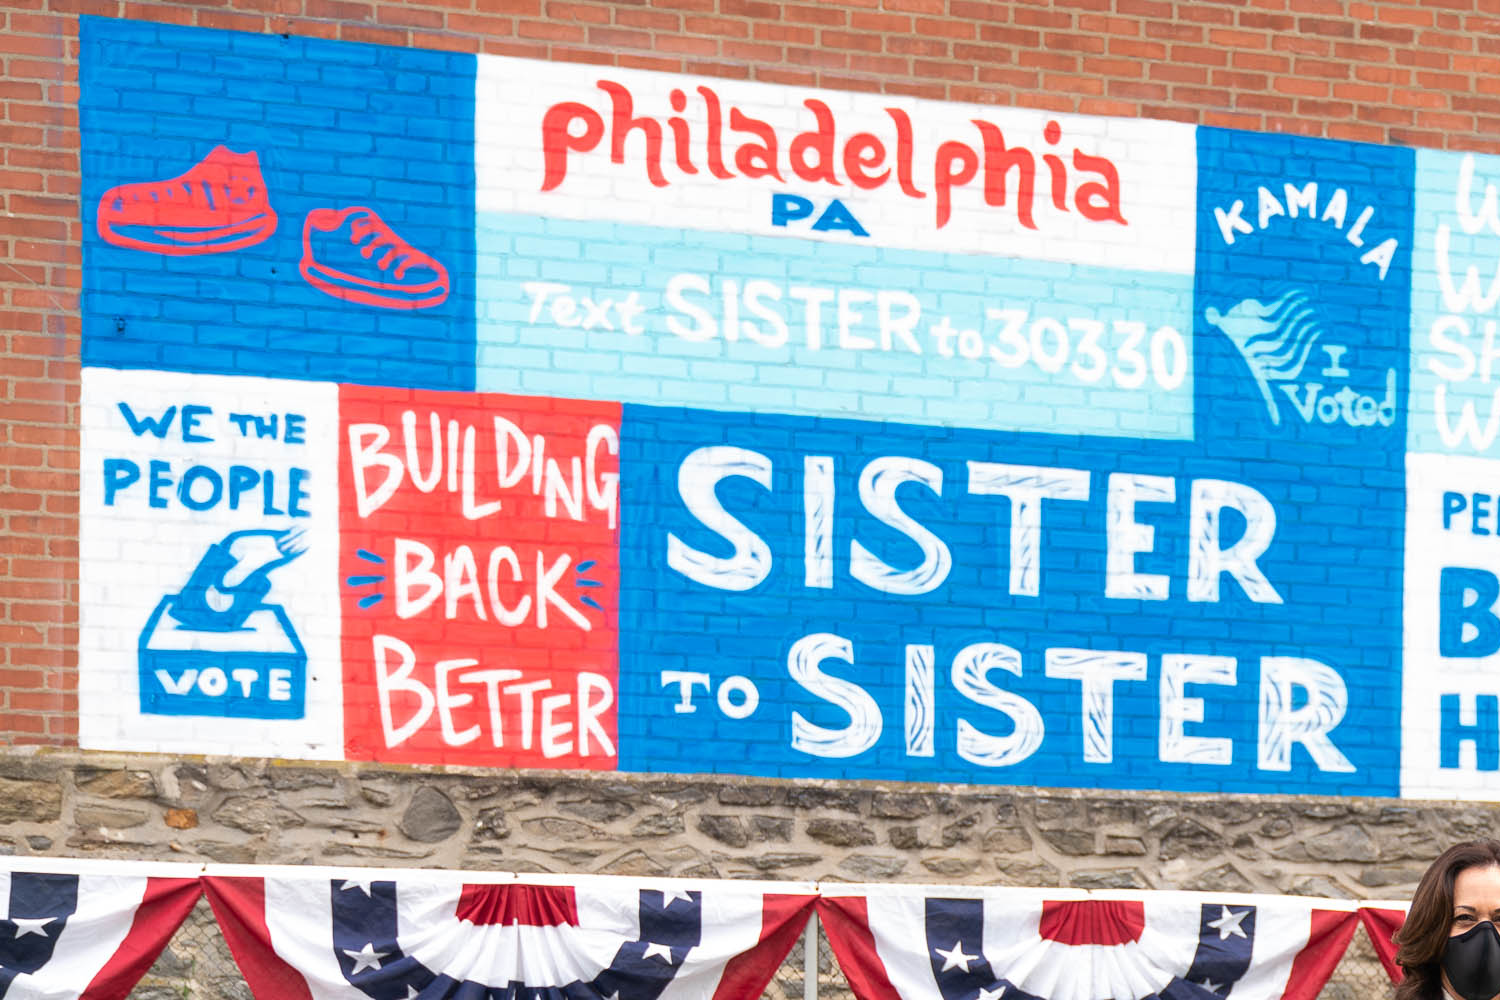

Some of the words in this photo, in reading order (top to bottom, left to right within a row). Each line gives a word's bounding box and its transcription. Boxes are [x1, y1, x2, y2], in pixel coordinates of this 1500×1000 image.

[540, 80, 1129, 232] philadelphia
[771, 193, 871, 237] PA
[1213, 182, 1399, 281] KAMALA
[522, 281, 646, 335] Text
[664, 273, 922, 354] SISTER
[930, 315, 985, 359] to
[986, 308, 1188, 391] 30330
[1322, 345, 1350, 377] I
[118, 402, 212, 444] WE
[229, 412, 307, 445] THE
[1279, 367, 1397, 427] Voted
[103, 459, 312, 518] PEOPLE
[348, 410, 620, 530] BUILDING
[667, 445, 1284, 604] SISTER
[394, 538, 592, 632] BACK
[154, 667, 292, 701] VOTE
[372, 634, 616, 760] BETTER
[661, 670, 760, 720] TO
[787, 632, 1357, 774] SISTER
